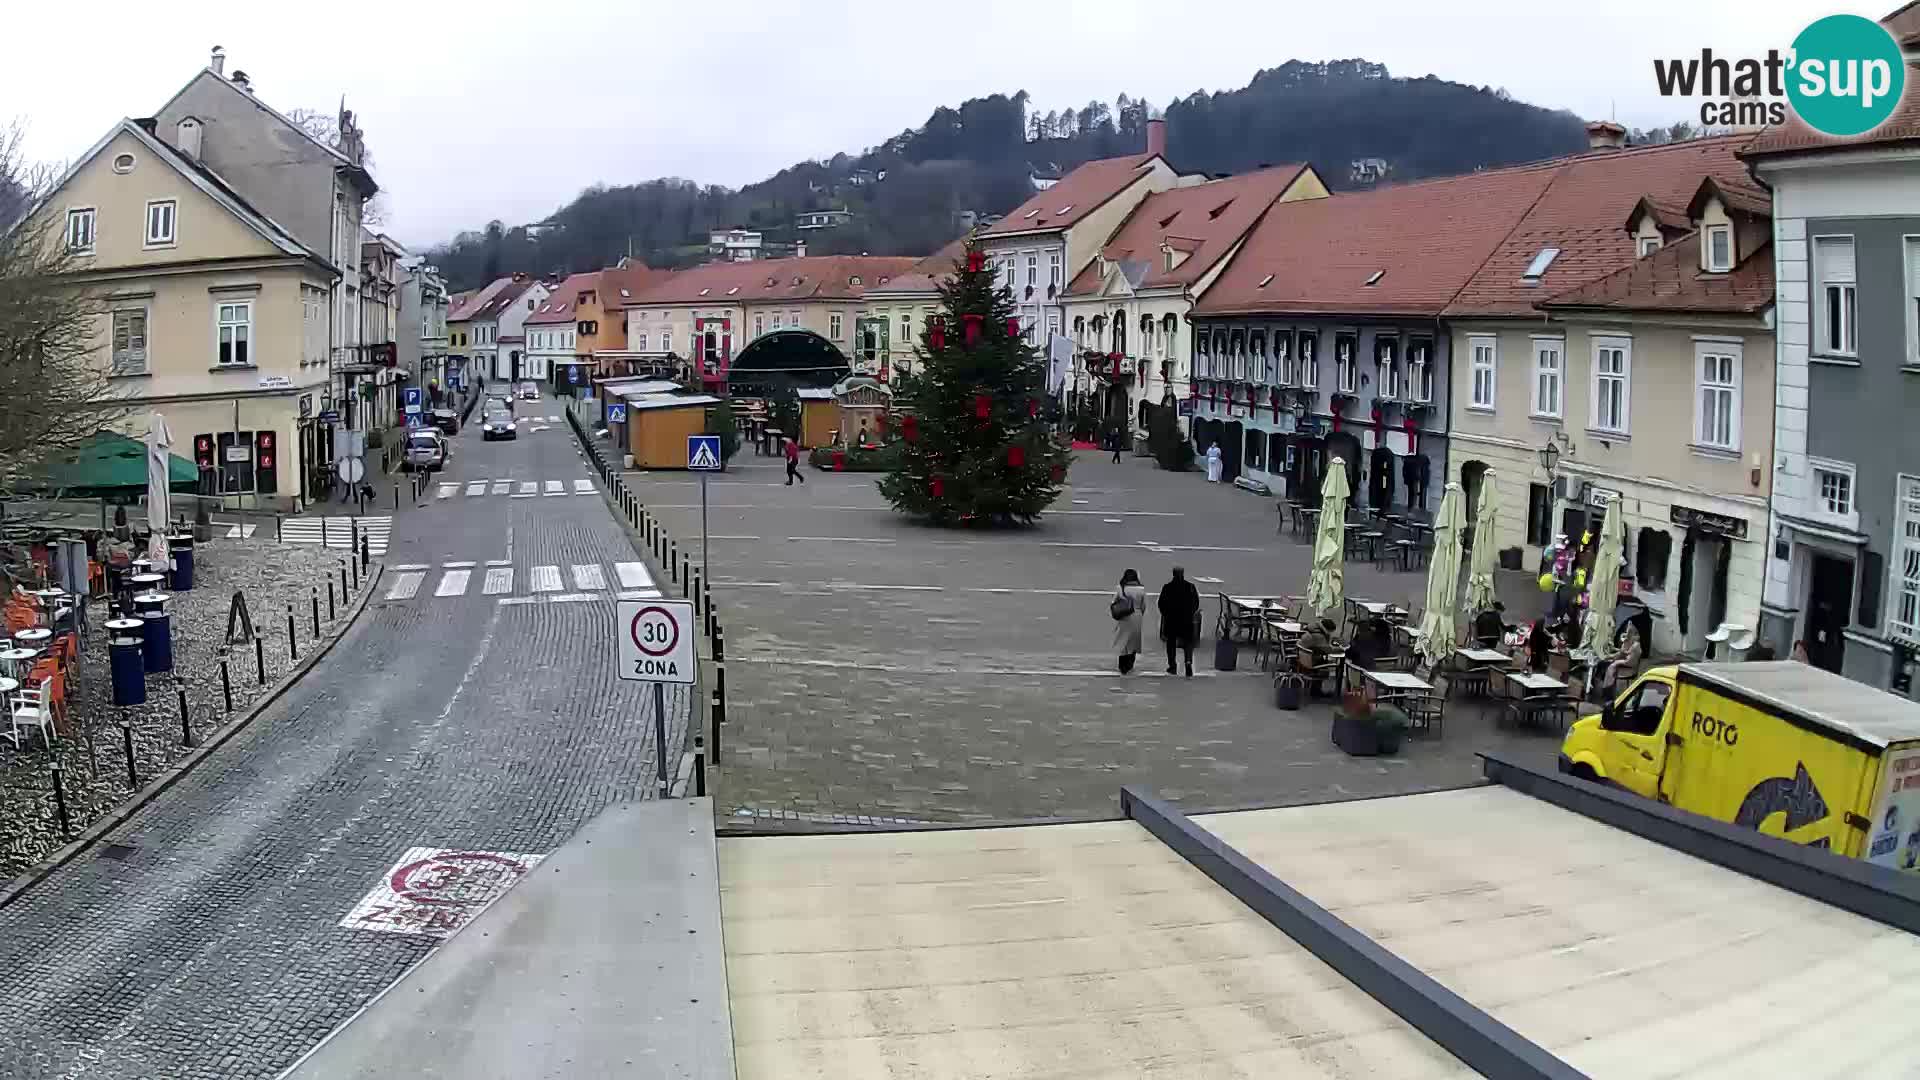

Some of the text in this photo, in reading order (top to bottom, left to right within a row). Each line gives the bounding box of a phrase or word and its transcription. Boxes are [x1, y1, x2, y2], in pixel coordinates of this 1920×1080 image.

[409, 391, 417, 402] P
[643, 622, 668, 643] 30
[634, 659, 678, 677] ZONA
[1691, 711, 1738, 746] ROTO
